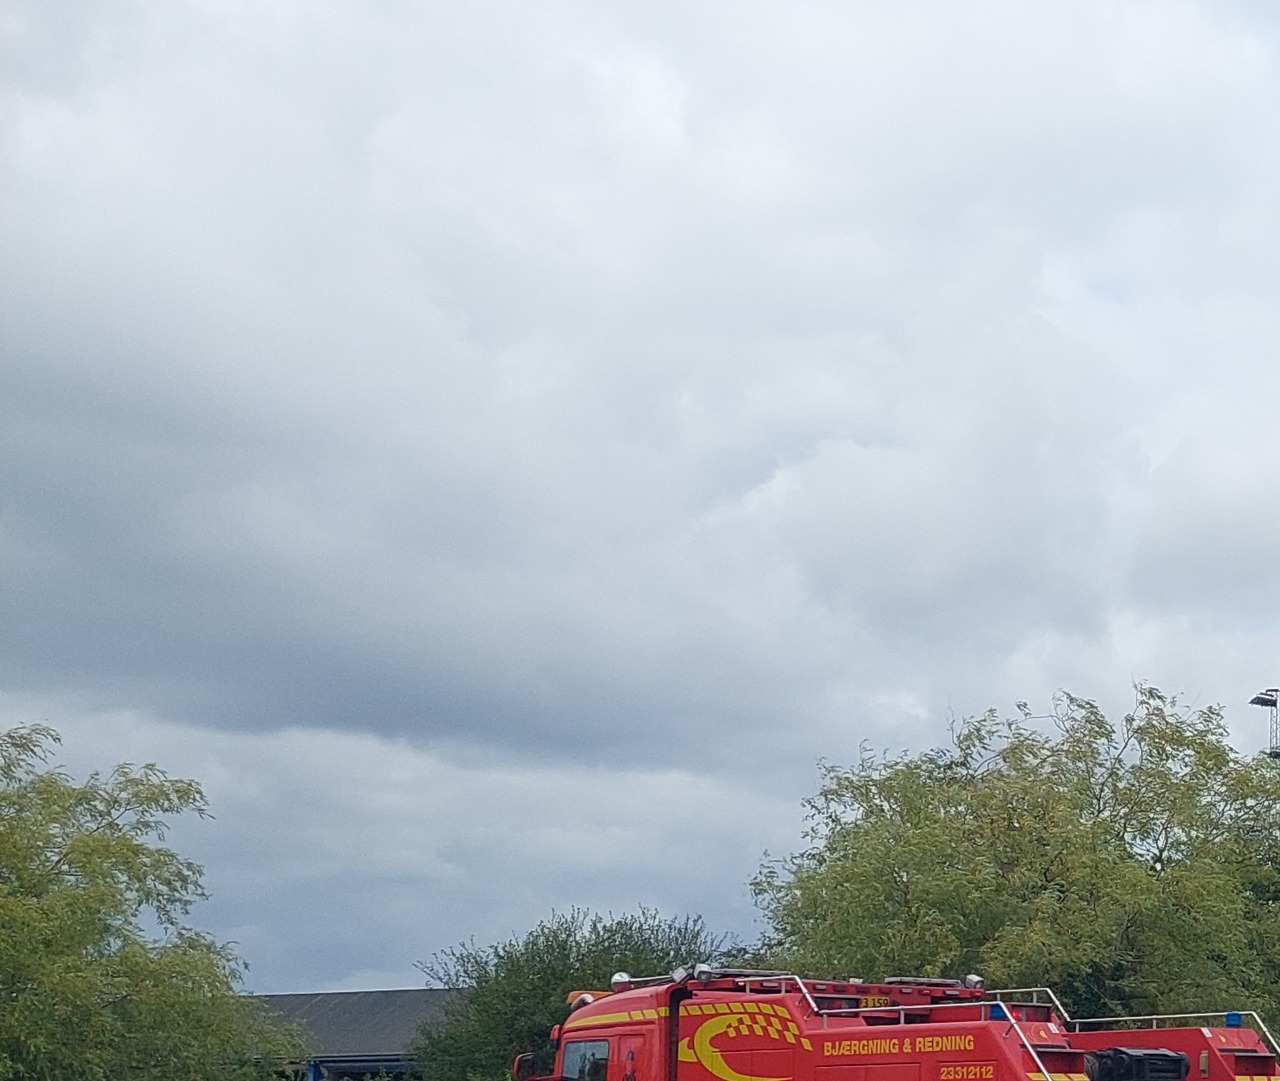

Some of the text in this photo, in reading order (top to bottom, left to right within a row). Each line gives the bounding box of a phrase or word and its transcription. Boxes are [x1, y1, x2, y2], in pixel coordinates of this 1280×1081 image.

[824, 1035, 975, 1056] BJÆRGNING & REDNING
[940, 1065, 994, 1080] 23312112
